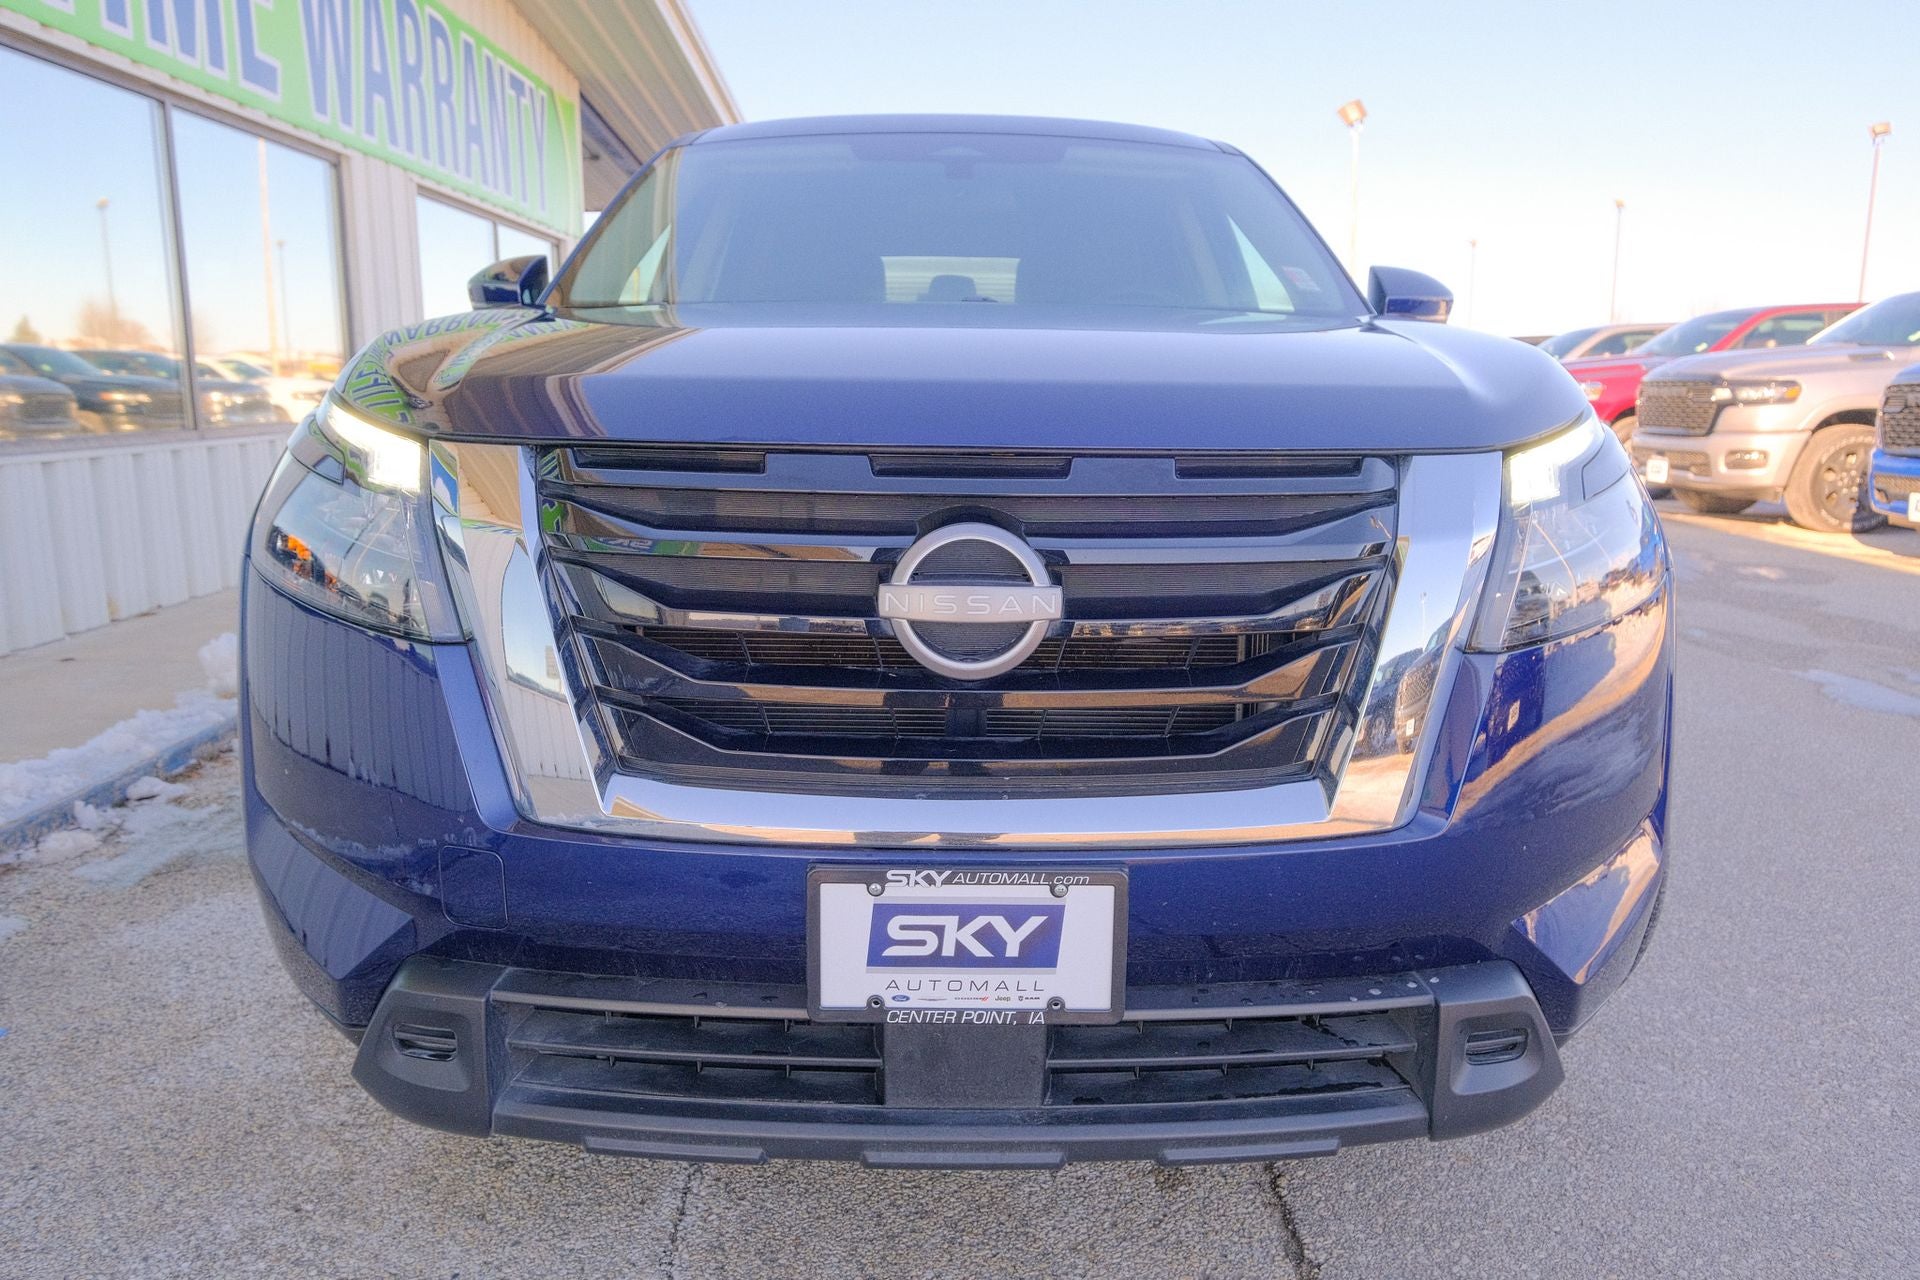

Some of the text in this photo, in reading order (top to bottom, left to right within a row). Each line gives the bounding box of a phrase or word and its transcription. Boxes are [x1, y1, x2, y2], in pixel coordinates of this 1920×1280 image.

[300, 0, 547, 214] WARRANTY
[884, 592, 1057, 615] NISSAN
[881, 915, 1049, 958] SKY
[885, 979, 1045, 992] AUTOMALL
[886, 1010, 1045, 1026] CENTER POINT, IA
